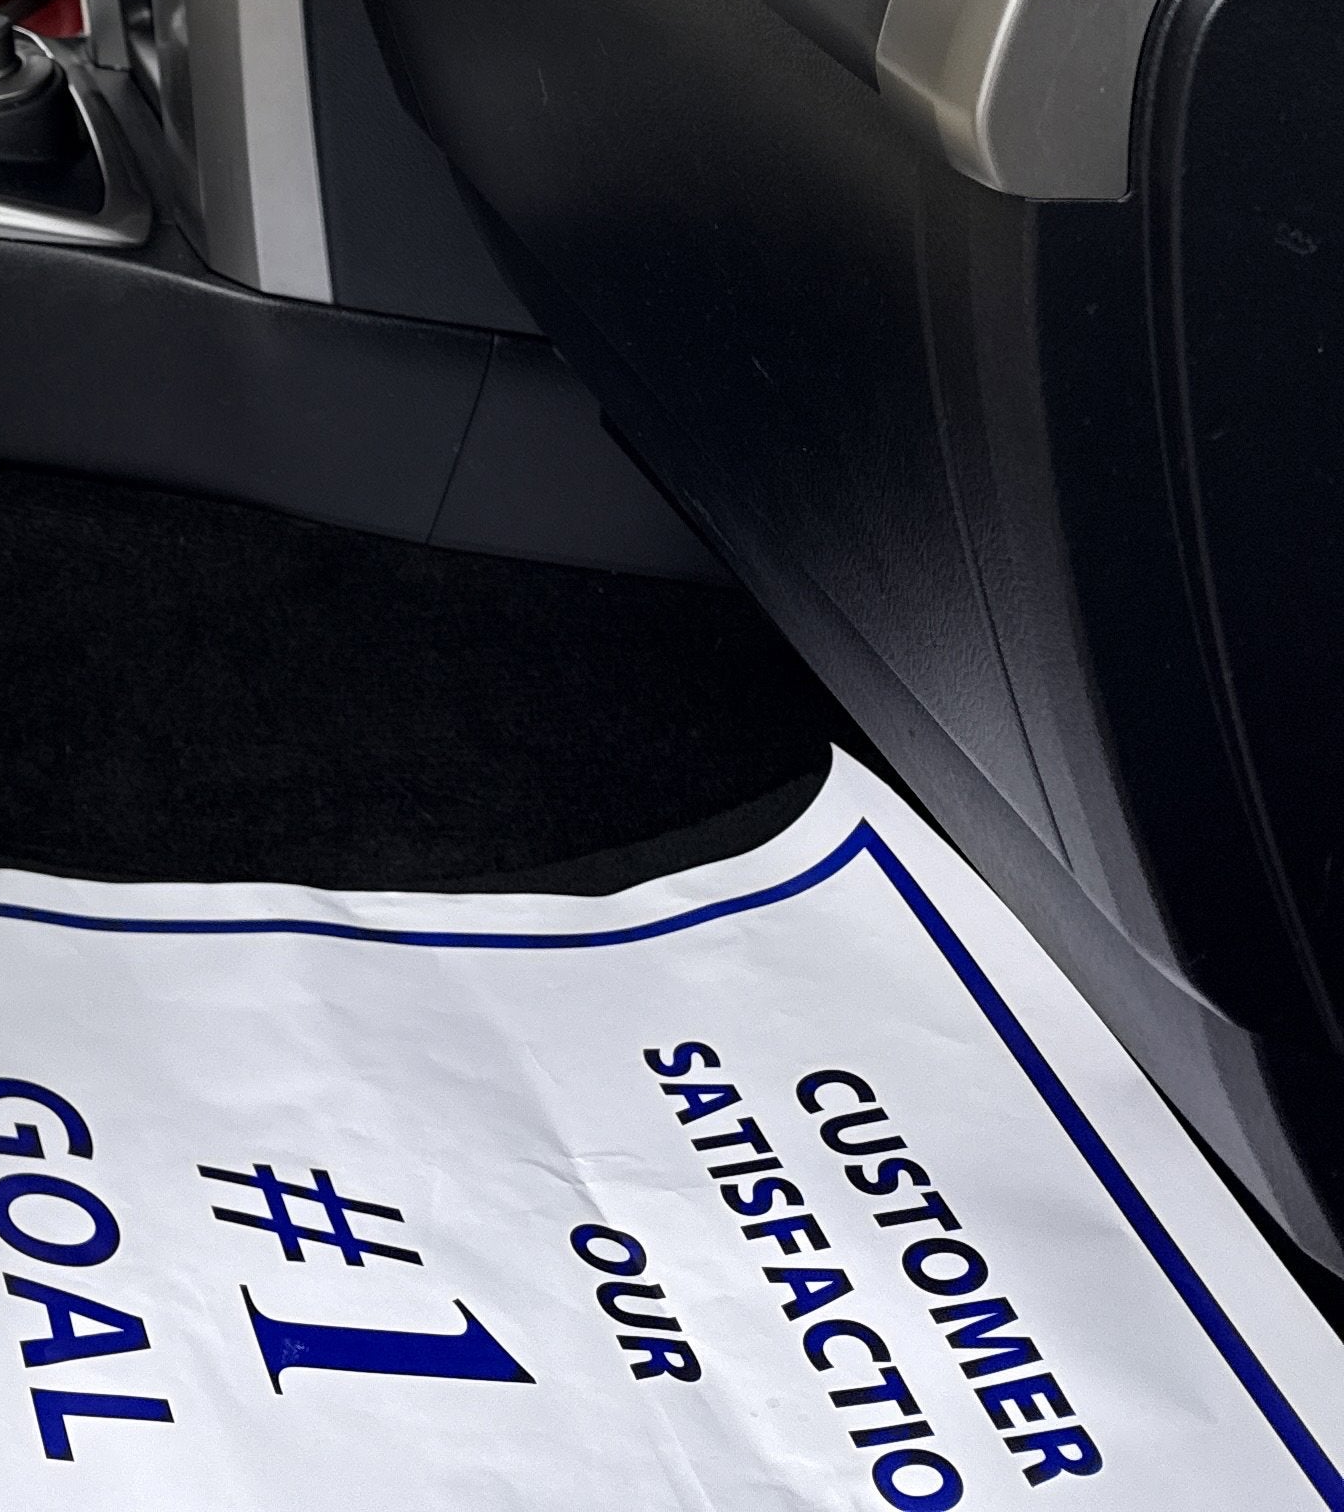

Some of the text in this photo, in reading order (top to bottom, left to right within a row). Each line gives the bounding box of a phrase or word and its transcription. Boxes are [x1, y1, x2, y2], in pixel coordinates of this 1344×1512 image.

[196, 1162, 538, 1397] #1
[569, 1222, 703, 1384] OUR
[642, 1039, 965, 1512] SATISFACTIO
[795, 1068, 1104, 1488] CUSTOMER
